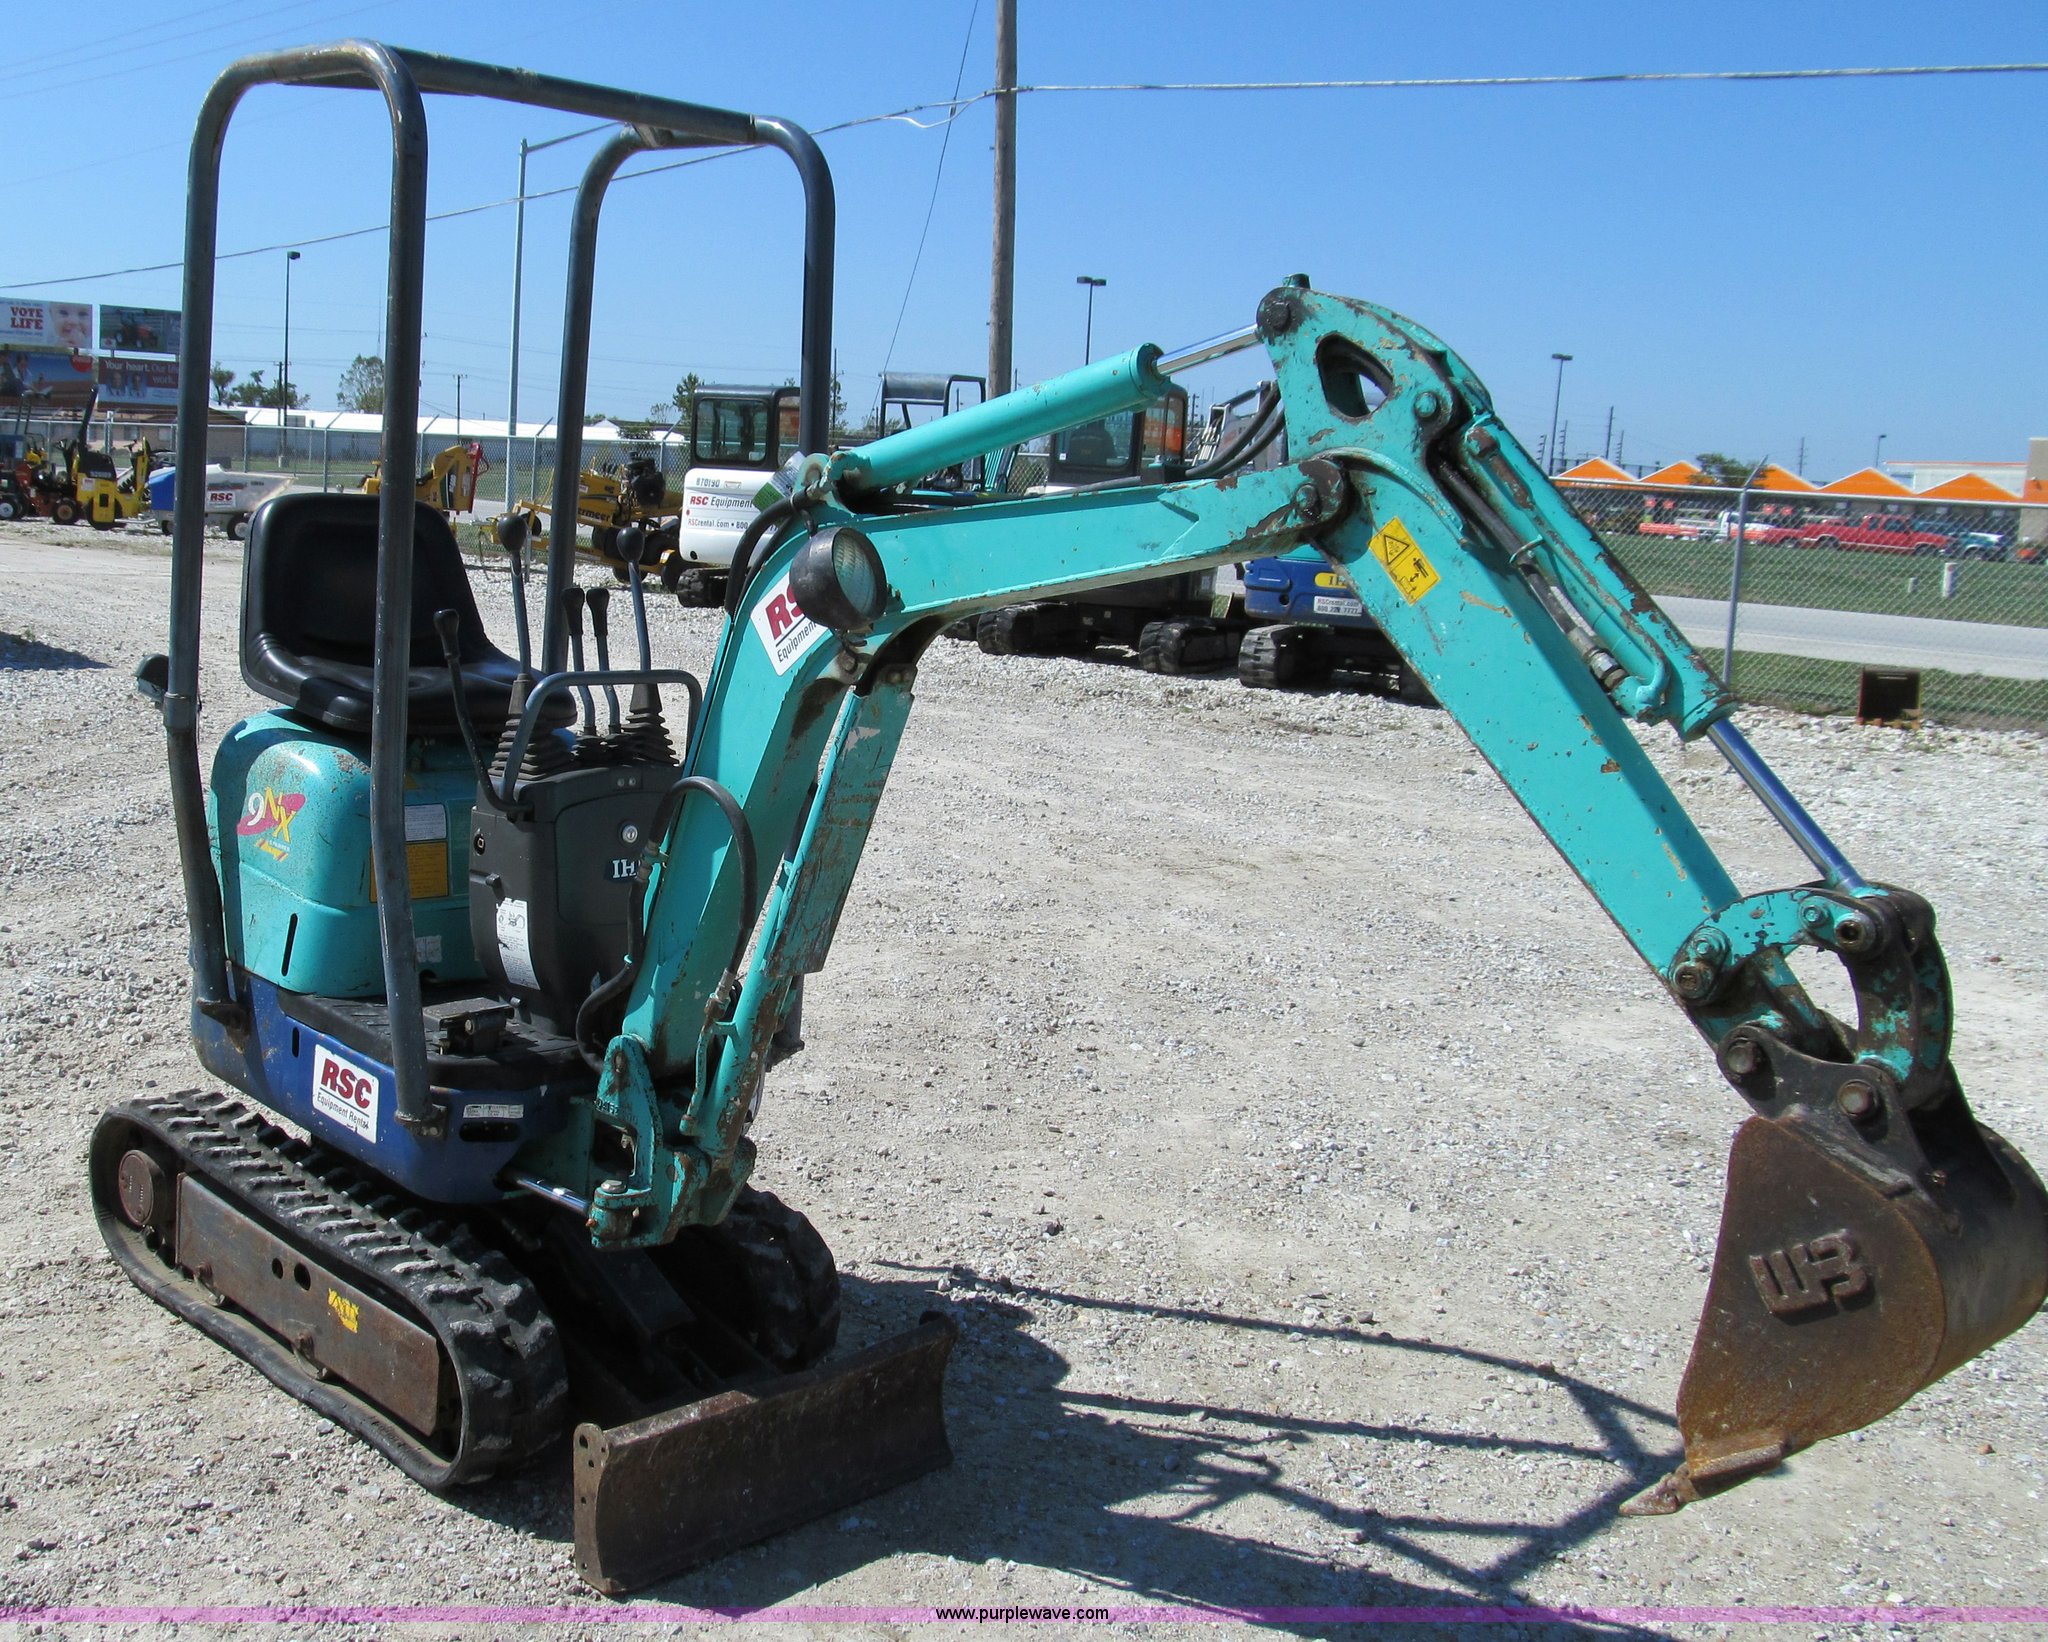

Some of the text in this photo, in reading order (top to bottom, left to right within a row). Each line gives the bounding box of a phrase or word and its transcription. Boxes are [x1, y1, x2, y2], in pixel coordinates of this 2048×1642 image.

[11, 306, 43, 318] VOTE
[11, 317, 43, 330] LIFE
[105, 360, 123, 369] Your
[210, 492, 233, 501] RSC
[690, 496, 709, 505] RSC
[687, 519, 730, 529] RSCrental.com
[612, 859, 640, 879] IH
[321, 1058, 372, 1109] RSC
[317, 1091, 348, 1118] Equipment
